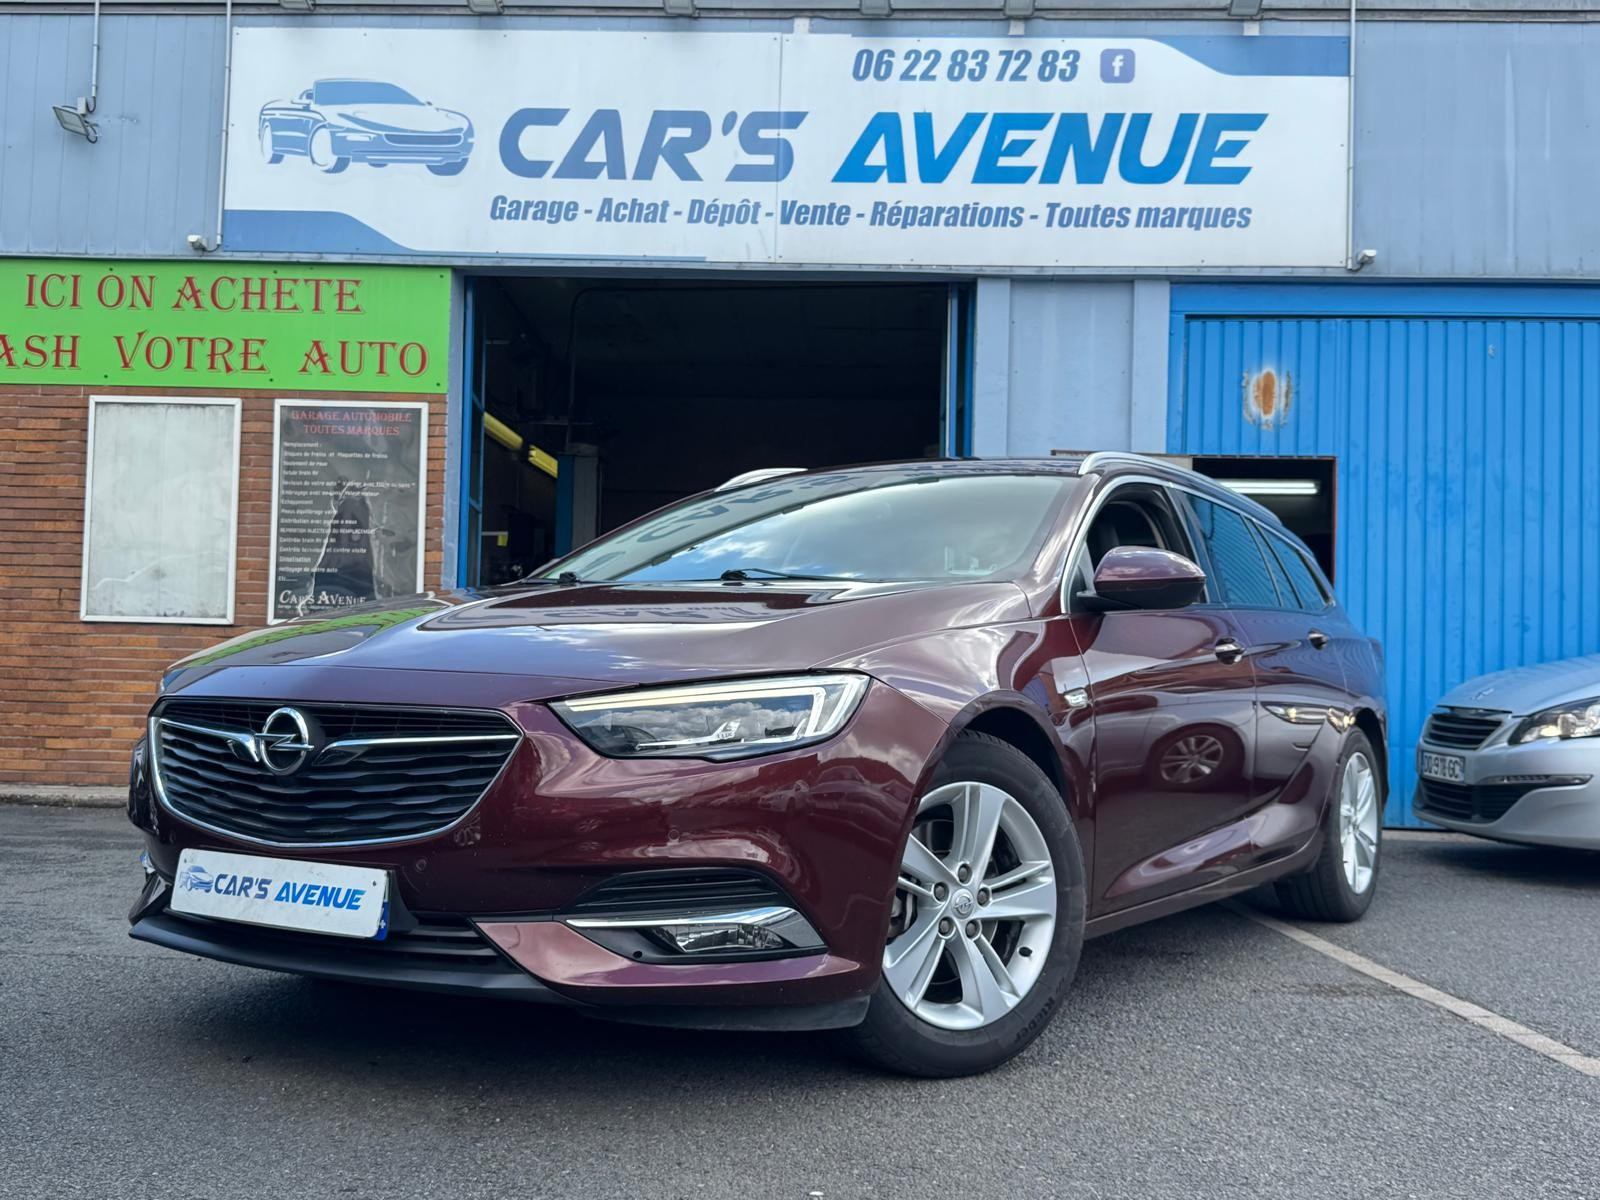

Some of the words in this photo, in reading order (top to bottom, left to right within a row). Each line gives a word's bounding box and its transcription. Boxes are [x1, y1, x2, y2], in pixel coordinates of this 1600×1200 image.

[852, 48, 895, 82] 06
[899, 49, 942, 82] 22
[946, 49, 990, 82] 83
[995, 50, 1033, 82] 72
[1037, 50, 1081, 82] 83
[499, 107, 809, 182] CAR'S
[831, 112, 1269, 185] AVENUE
[490, 195, 579, 224] Garage
[596, 198, 671, 223] Achat
[687, 198, 761, 227] Dépôt
[779, 200, 850, 226] Vente
[869, 201, 1024, 229] Réparations
[1046, 203, 1130, 228] Toutes
[1135, 206, 1252, 231] marques
[25, 273, 83, 309] ICI
[97, 274, 157, 310] ON
[172, 275, 366, 314] ACHETE
[113, 329, 270, 375] VOTRE
[298, 340, 430, 377] AUTO
[291, 411, 340, 421] GARAGE
[303, 424, 345, 435] TOUTES
[346, 425, 400, 436] MARQUES
[214, 873, 273, 900] CAR'S
[274, 881, 367, 911] AVENUE
